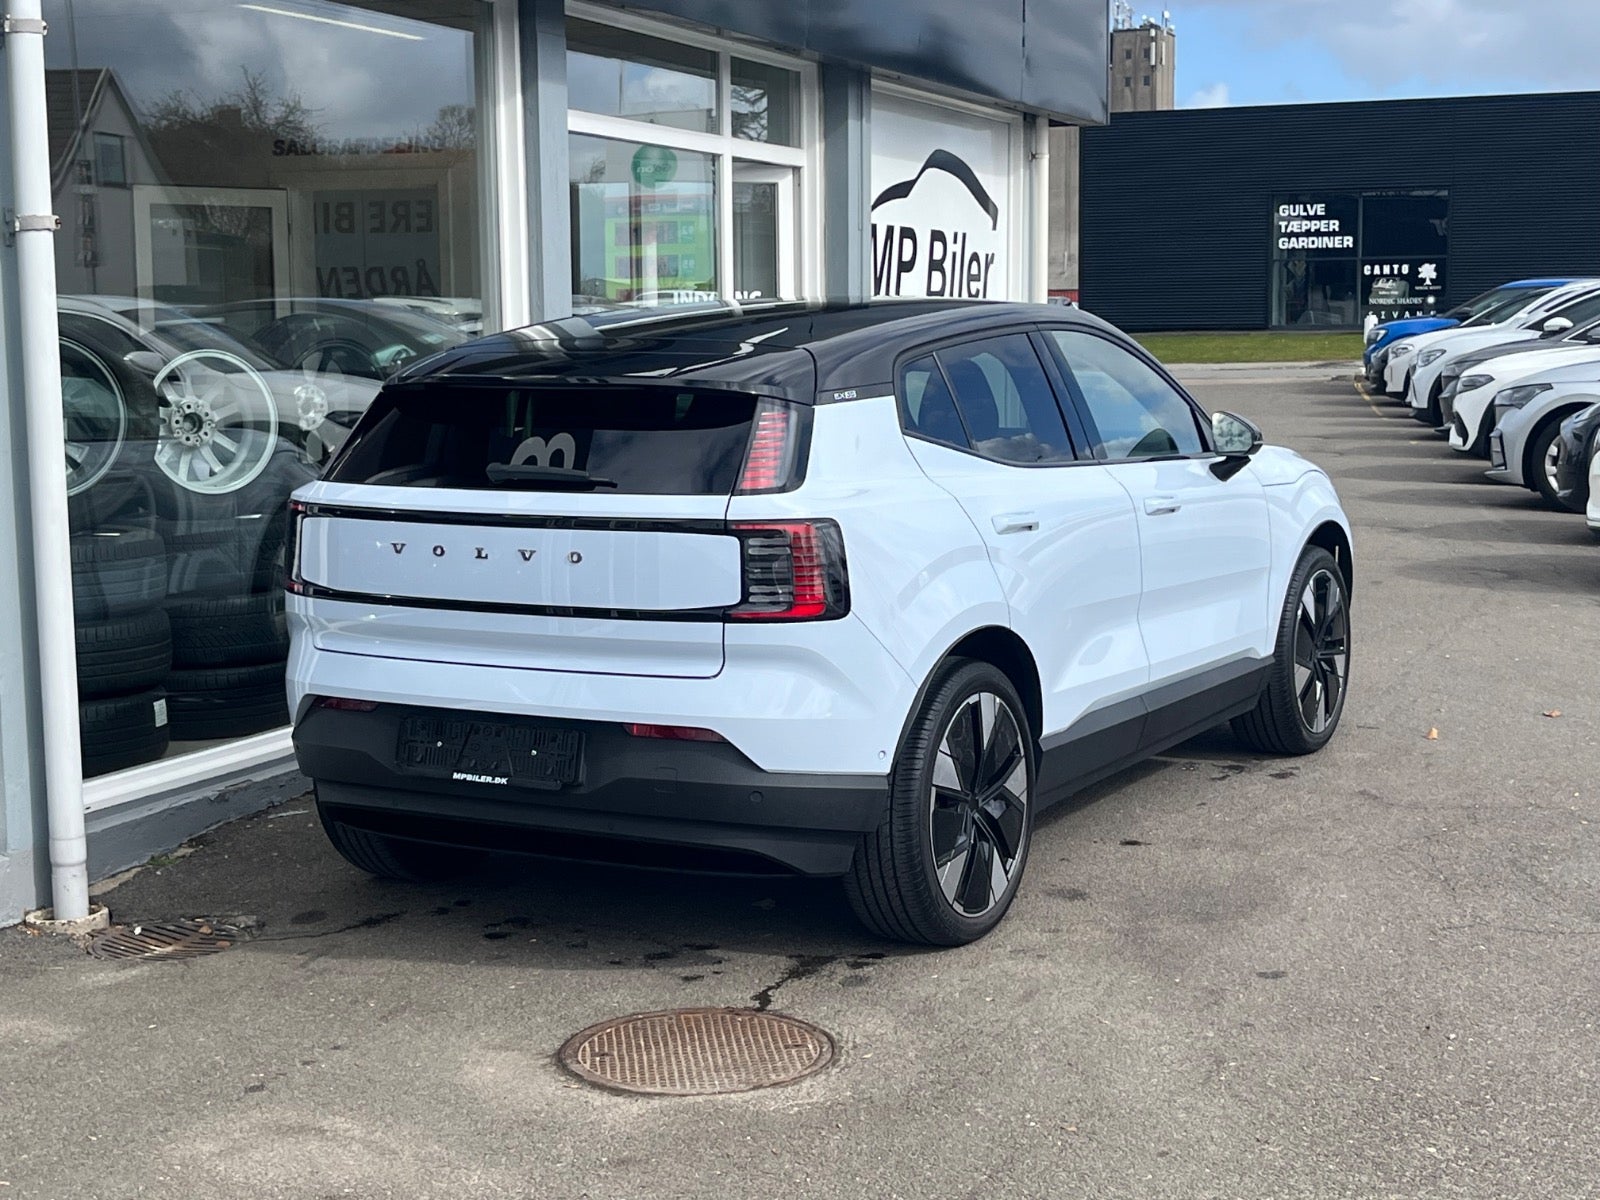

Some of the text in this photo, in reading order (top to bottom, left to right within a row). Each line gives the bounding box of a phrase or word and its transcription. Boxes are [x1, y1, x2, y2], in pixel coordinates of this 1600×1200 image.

[1279, 204, 1325, 216] GULVE
[1279, 220, 1340, 233] TÆPPER
[1278, 236, 1354, 249] GARDINER
[871, 223, 995, 299] MP Biler
[1363, 264, 1409, 275] CANTO
[391, 543, 582, 563] VOLVO
[453, 772, 508, 784] MPBILER.DK
